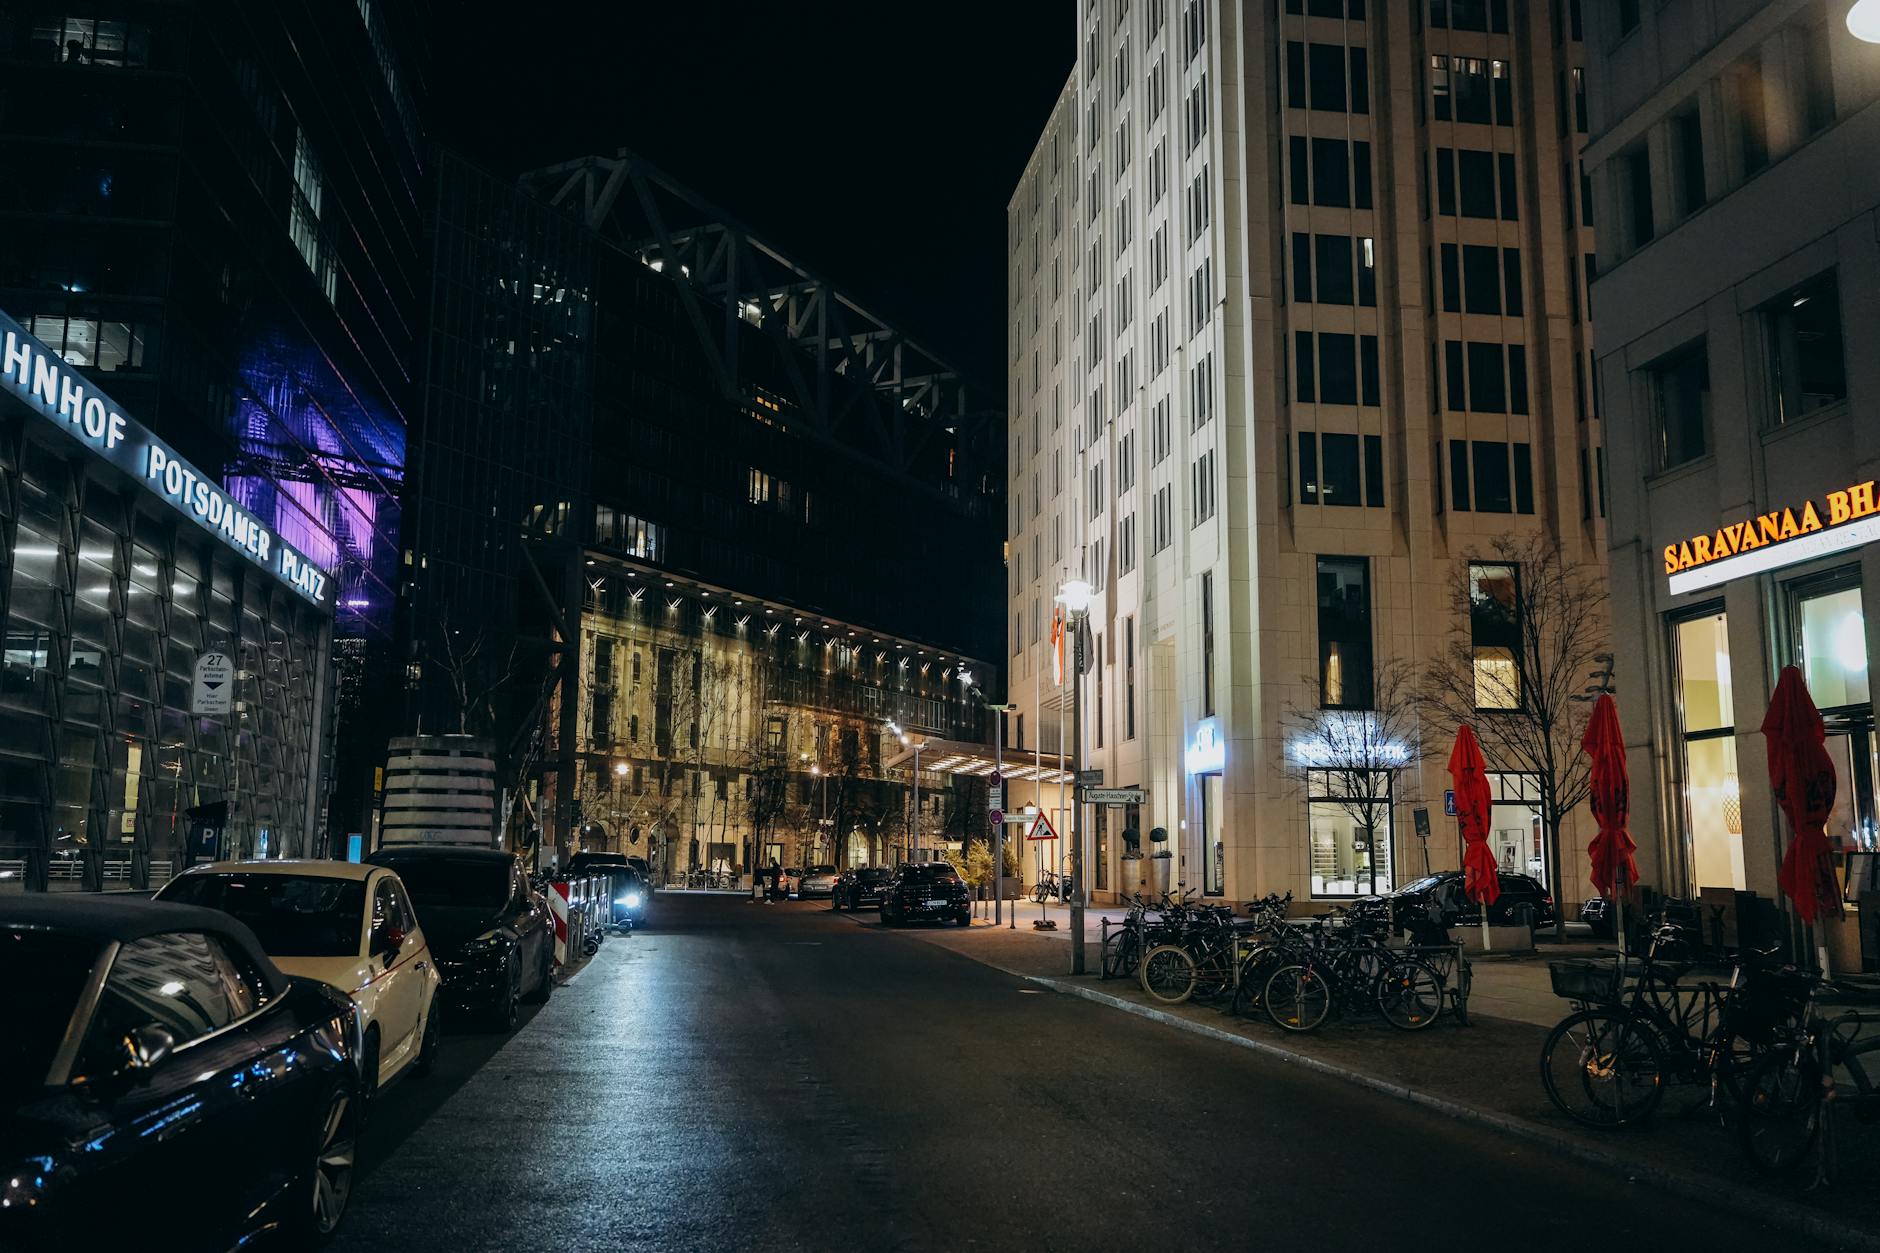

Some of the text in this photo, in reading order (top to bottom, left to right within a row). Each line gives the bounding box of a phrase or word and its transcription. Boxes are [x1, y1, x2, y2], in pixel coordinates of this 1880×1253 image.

[3, 331, 326, 602] HNHOF POTSDAMER PLATZ
[1663, 499, 1823, 575] SARAVANAA
[207, 654, 223, 666] 27
[202, 828, 214, 845] P
